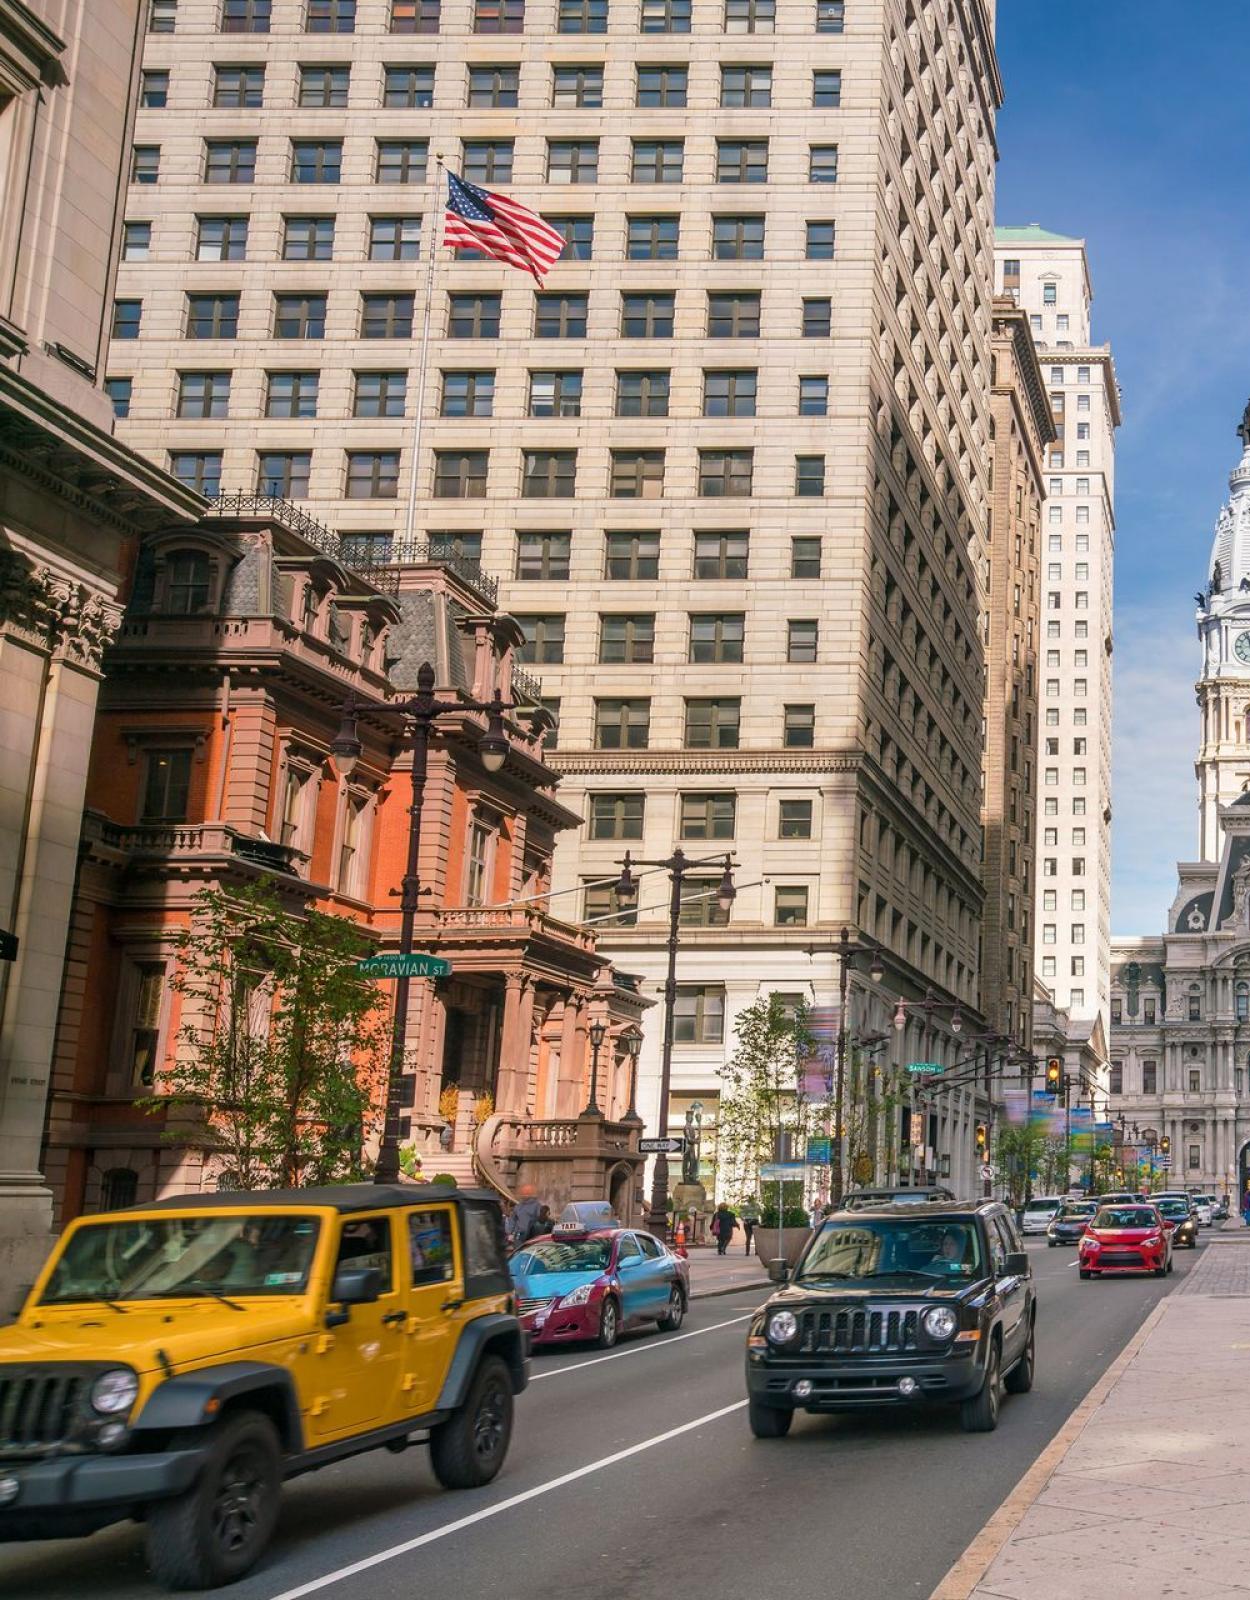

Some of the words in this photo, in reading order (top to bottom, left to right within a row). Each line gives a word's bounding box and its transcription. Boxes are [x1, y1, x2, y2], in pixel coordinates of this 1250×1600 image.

[360, 963, 429, 975] MORAVIAN
[433, 965, 444, 975] ST
[909, 1064, 936, 1072] SANSOM
